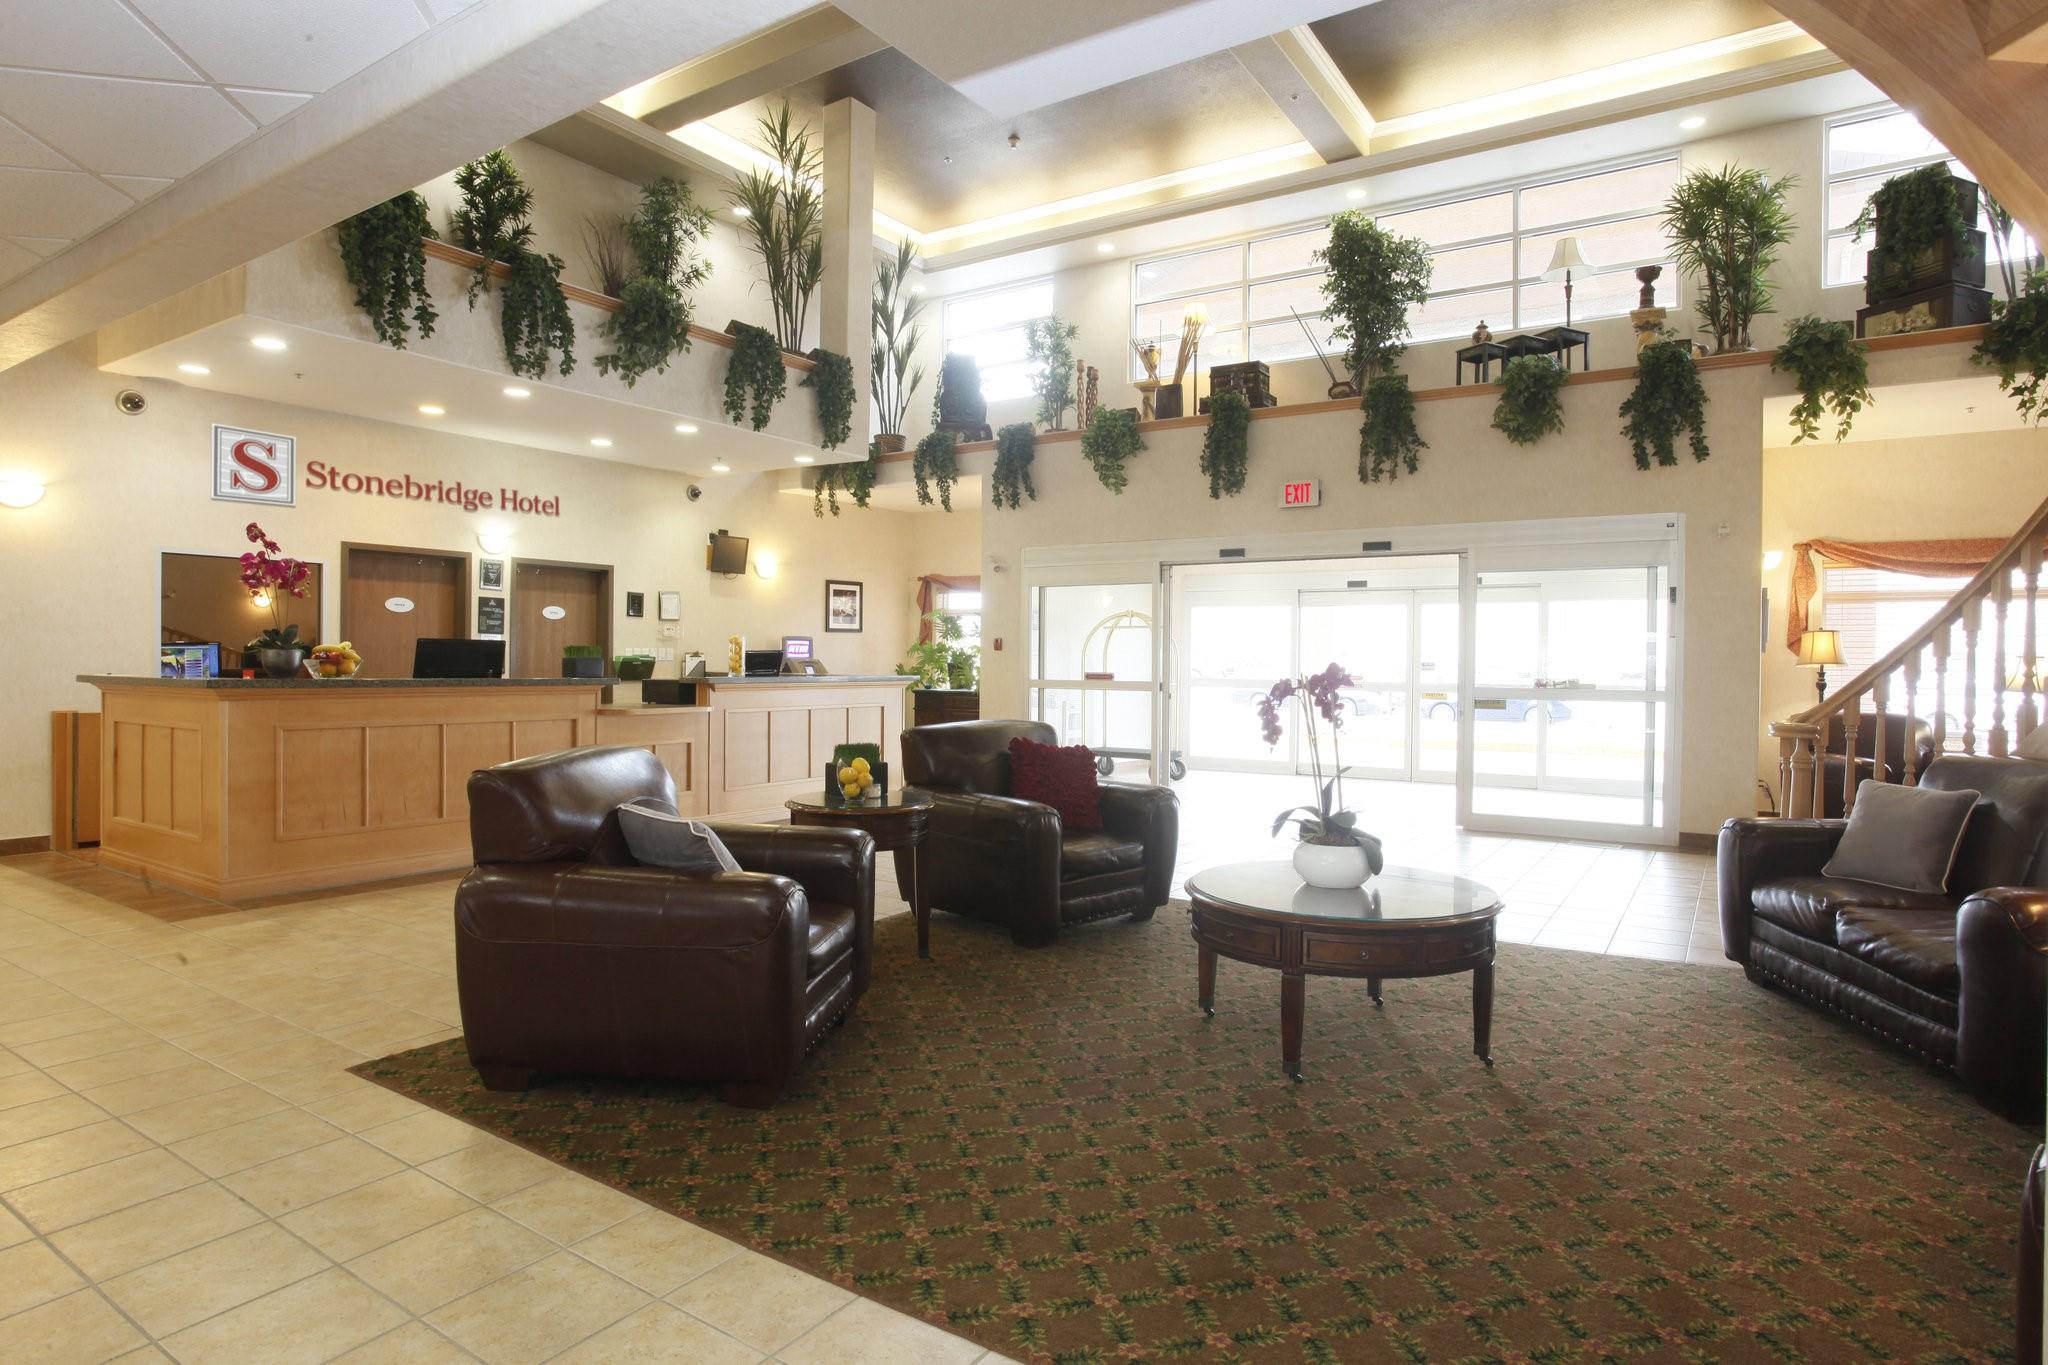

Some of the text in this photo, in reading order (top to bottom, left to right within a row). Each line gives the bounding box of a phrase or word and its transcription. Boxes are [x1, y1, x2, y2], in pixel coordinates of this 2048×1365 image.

[231, 440, 281, 494] S
[306, 460, 560, 517] Stonebridge Hotel
[1285, 482, 1311, 505] EXIT
